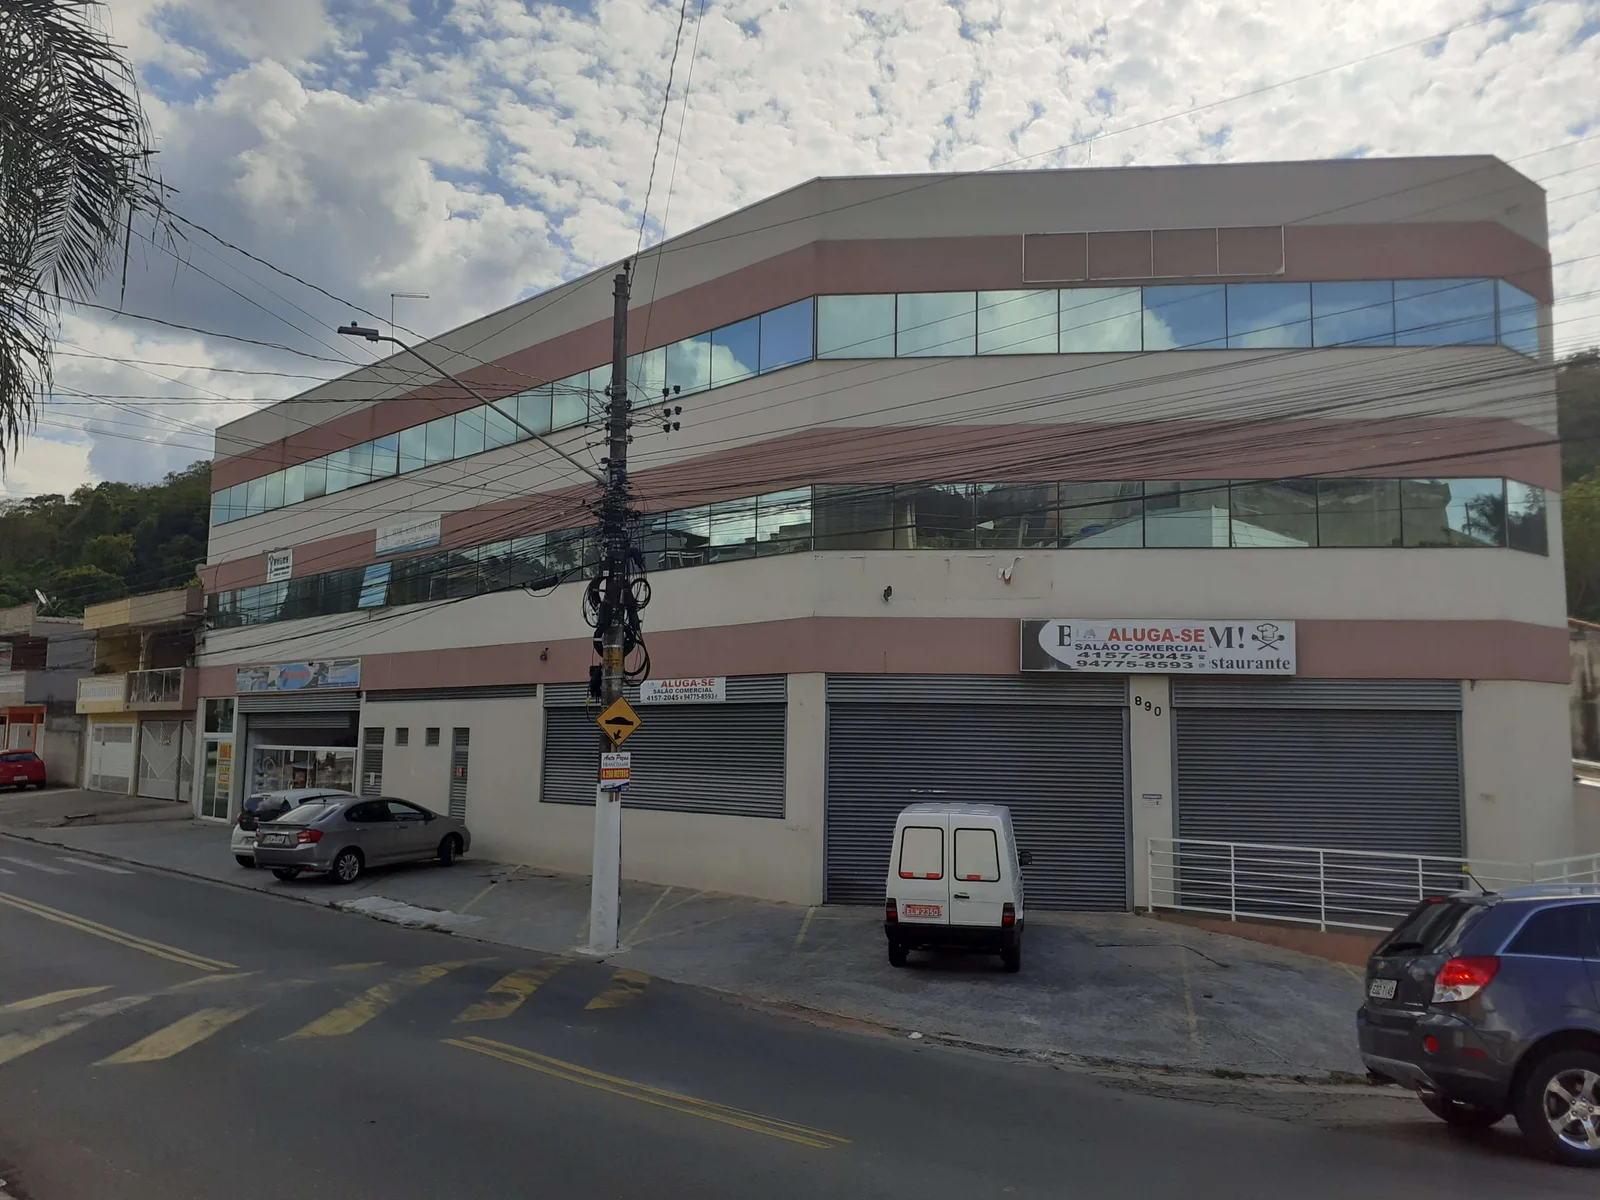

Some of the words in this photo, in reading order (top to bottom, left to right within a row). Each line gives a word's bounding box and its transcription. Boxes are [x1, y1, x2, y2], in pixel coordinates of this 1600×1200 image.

[1107, 628, 1205, 643] ALUGA-SE
[1074, 643, 1121, 652] SALÃO
[1124, 644, 1208, 653] COMERCIAL
[1076, 651, 1193, 661] 4157-2045
[1075, 660, 1194, 669] 94775-8593
[1208, 657, 1291, 670] staurante
[661, 679, 715, 687] ALUGA-SE
[1134, 695, 1162, 717] 890
